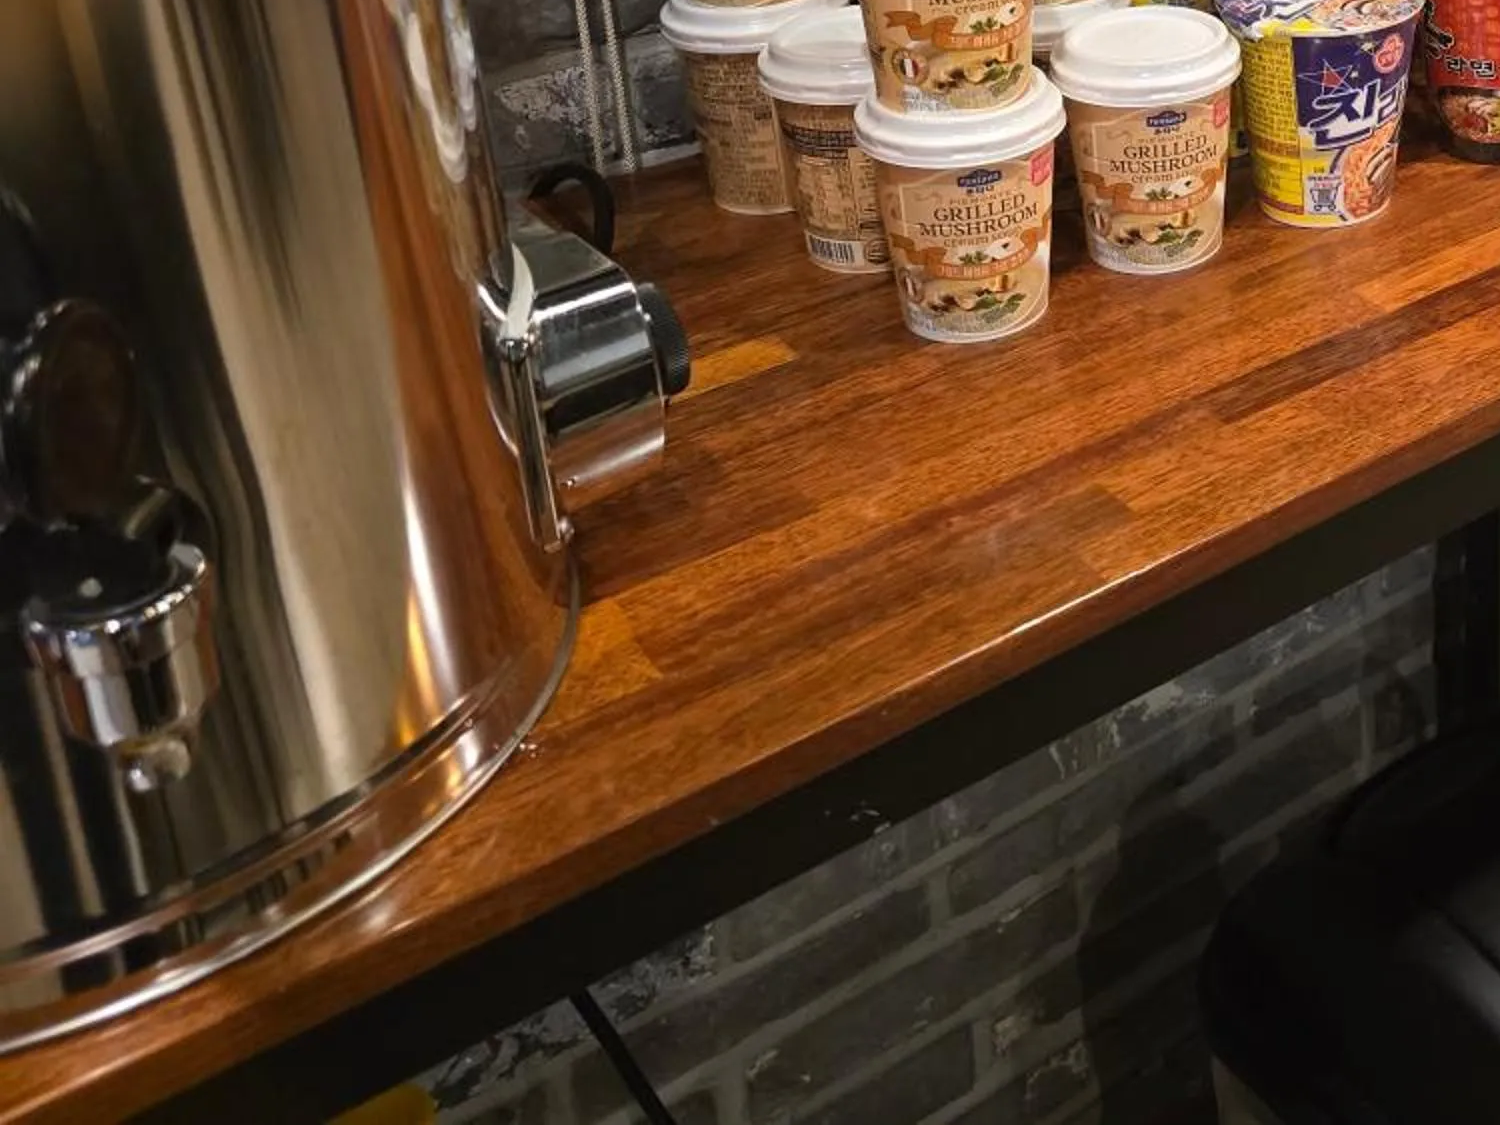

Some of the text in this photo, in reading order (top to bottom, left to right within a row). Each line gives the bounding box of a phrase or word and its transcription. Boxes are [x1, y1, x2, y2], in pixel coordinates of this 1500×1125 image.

[1444, 55, 1497, 80] 라면
[1308, 77, 1408, 151] 진라
[1109, 144, 1217, 173] MUSHROOM
[1123, 134, 1207, 159] GRILLED
[918, 202, 1038, 237] MUSHROOM
[933, 194, 1026, 222] GRILLED
